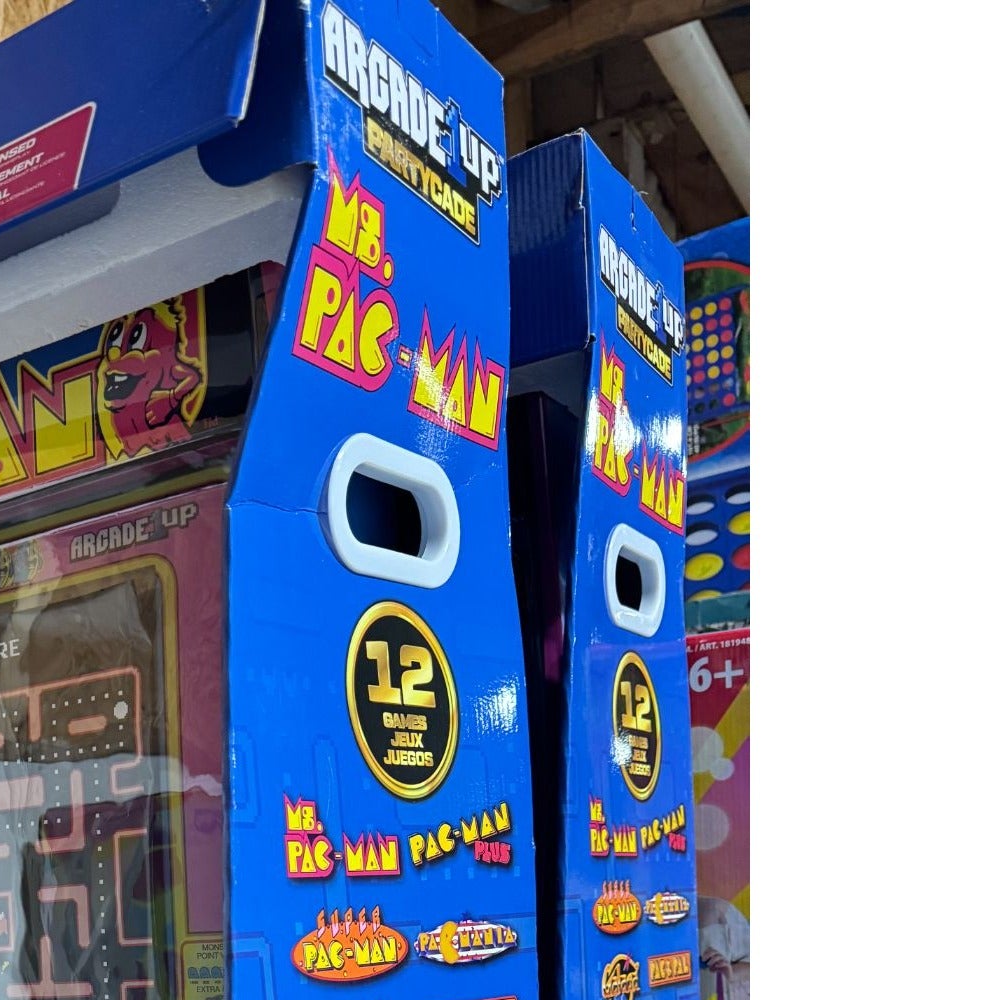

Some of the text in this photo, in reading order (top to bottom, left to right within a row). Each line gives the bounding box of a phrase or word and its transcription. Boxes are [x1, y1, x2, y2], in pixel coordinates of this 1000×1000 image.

[366, 116, 476, 235] PARTYCADE
[296, 260, 503, 444] PAC-MAN
[617, 303, 672, 381] PARTYCADE
[699, 641, 719, 651] ART.
[365, 640, 436, 709] 12
[689, 655, 744, 693] 6+
[382, 712, 428, 731] GAMES
[620, 681, 653, 732] 12
[383, 749, 434, 767] JUEGOS
[390, 732, 424, 749] JEUX
[408, 802, 511, 865] PAC-MAN
[590, 827, 638, 855] PAC-MAN
[640, 804, 686, 849] PAC-MAN
[285, 835, 400, 876] PAC-MAN
[474, 840, 511, 864] PLUS
[316, 905, 381, 939] SUPER
[597, 902, 638, 926] PAC-MAN
[197, 952, 219, 960] POINT
[302, 935, 399, 972] PAC-MAN
[197, 985, 221, 993] EXTRA
